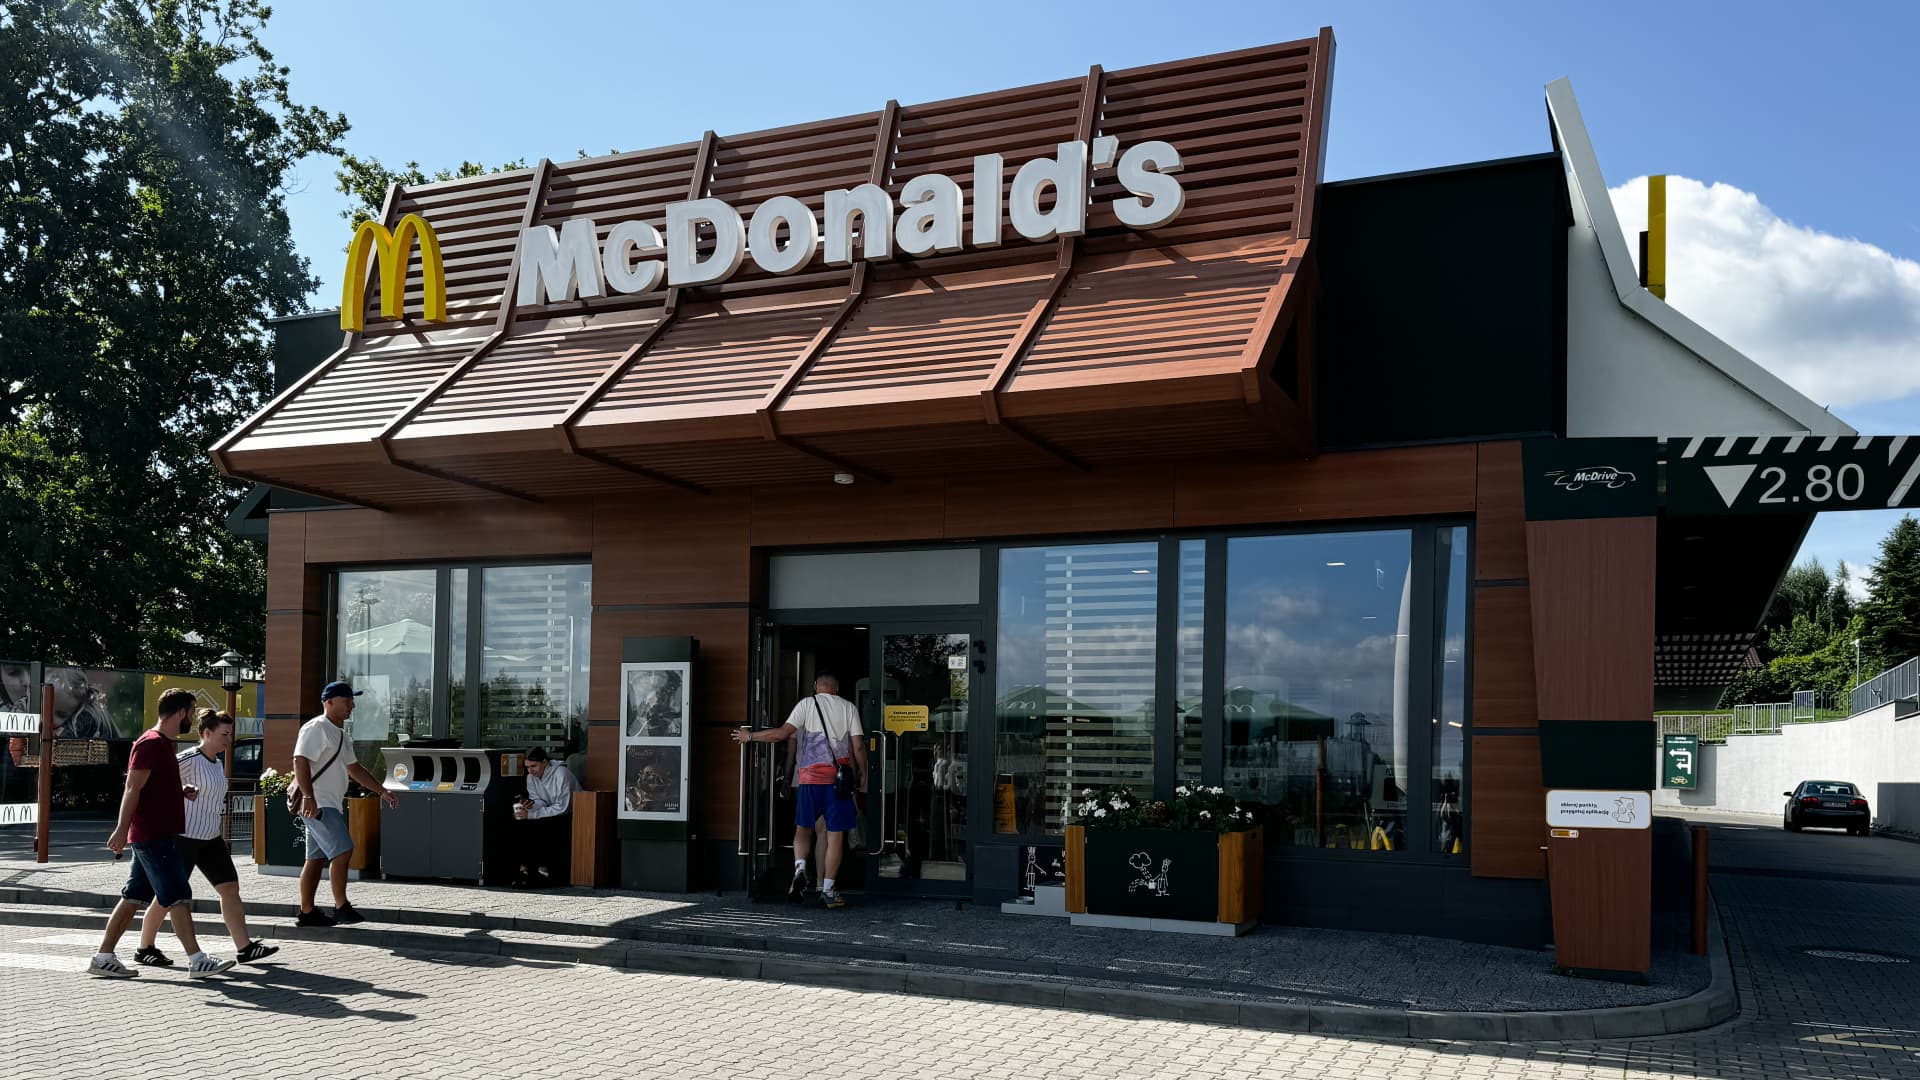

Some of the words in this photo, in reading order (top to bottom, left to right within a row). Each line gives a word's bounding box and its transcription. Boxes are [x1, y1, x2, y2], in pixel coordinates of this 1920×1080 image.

[516, 135, 1185, 307] McDonald's
[1574, 471, 1618, 482] McDrive
[1758, 463, 1865, 504] 2.80
